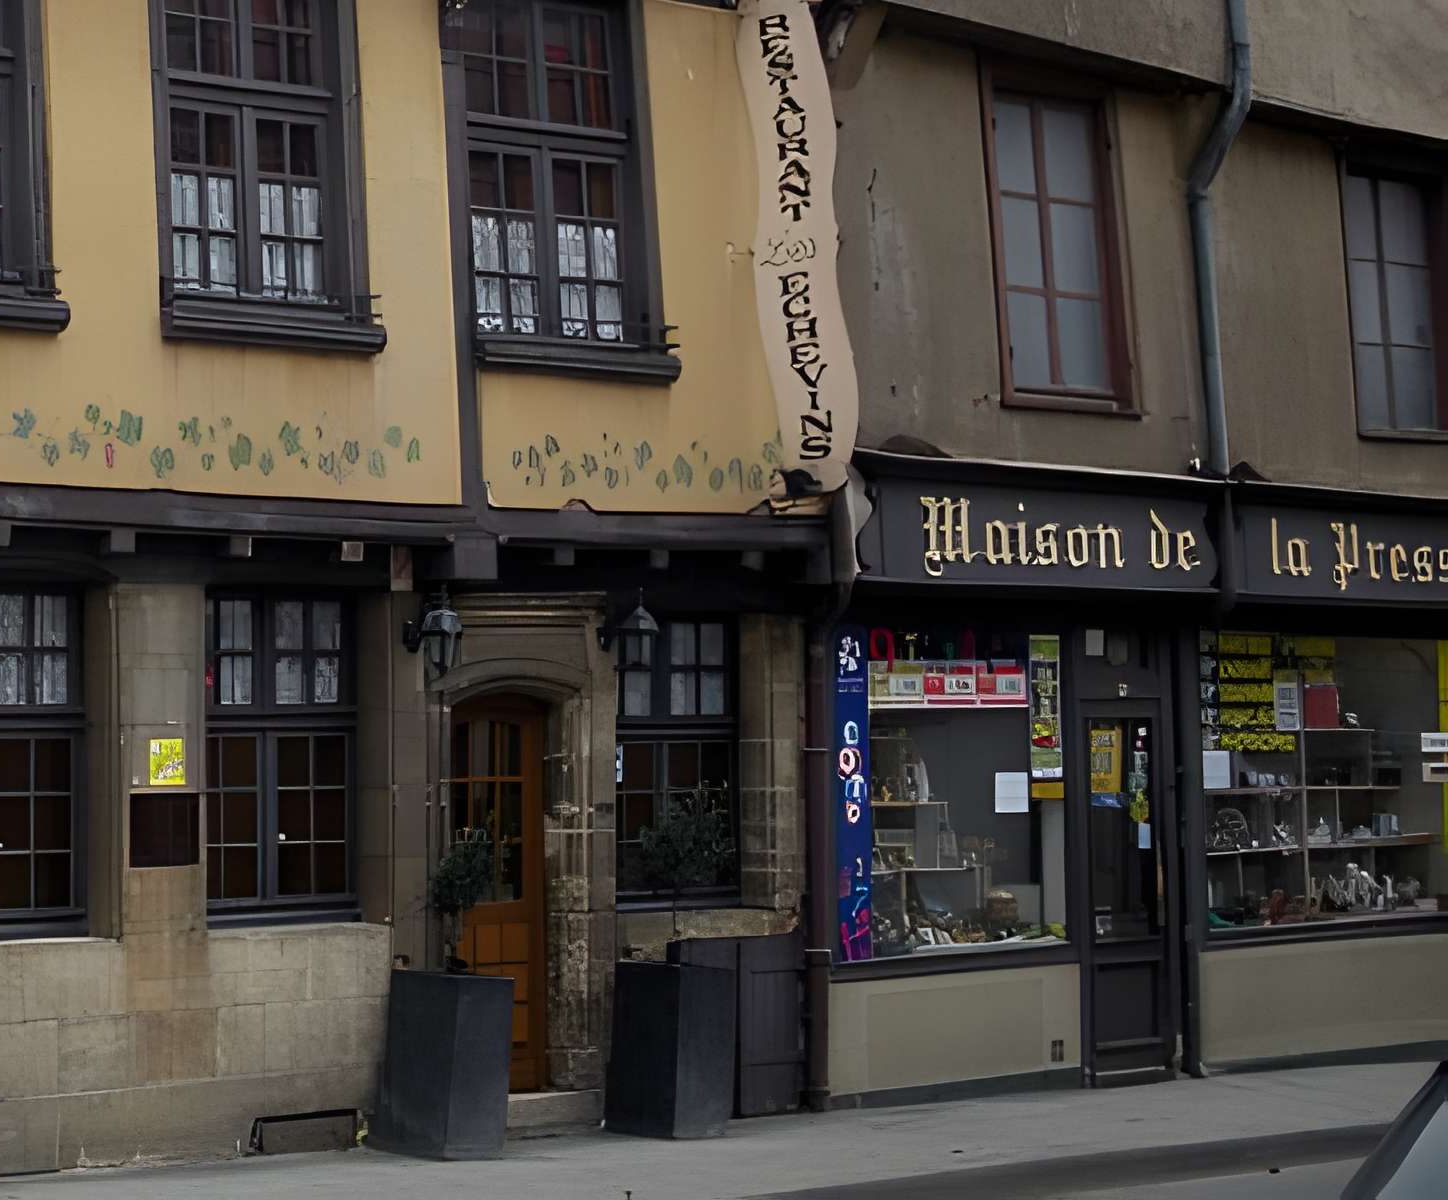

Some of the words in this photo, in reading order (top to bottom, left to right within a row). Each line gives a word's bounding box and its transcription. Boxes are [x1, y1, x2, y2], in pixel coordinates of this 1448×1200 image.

[758, 14, 812, 222] RESTAURANT
[777, 271, 834, 460] ECHEVINS
[919, 495, 1126, 577] Maison
[1147, 507, 1201, 572] de
[1271, 517, 1312, 577] la
